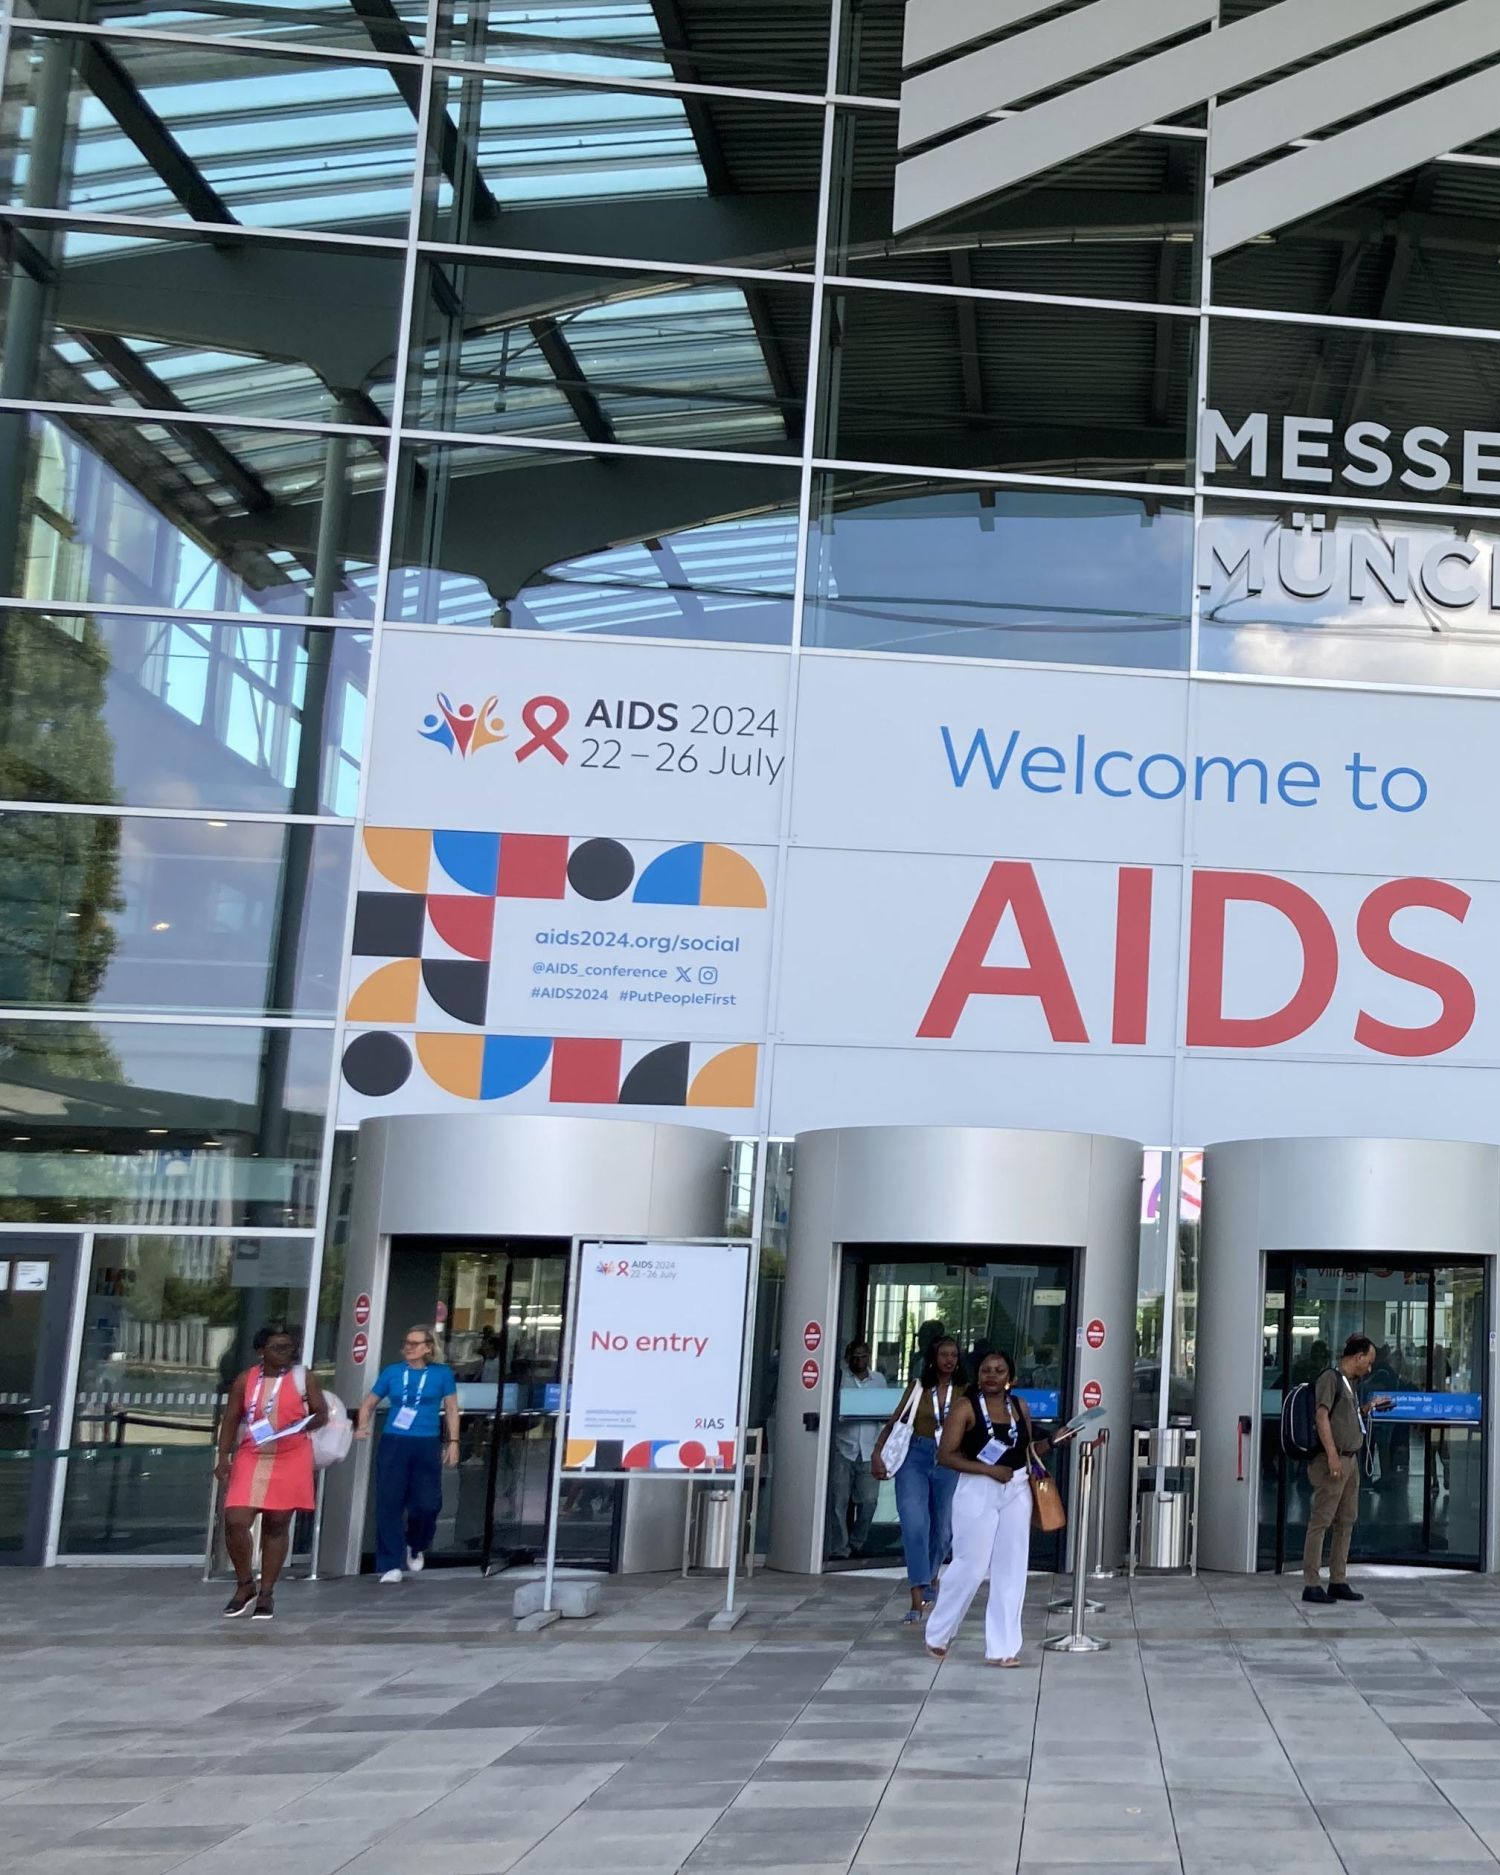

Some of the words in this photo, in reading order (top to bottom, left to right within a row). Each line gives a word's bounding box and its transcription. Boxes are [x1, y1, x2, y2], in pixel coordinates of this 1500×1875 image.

[584, 698, 679, 733] AIDS
[690, 704, 779, 738] 2024
[708, 746, 785, 786] July
[940, 725, 1321, 807] Welcome
[1345, 752, 1428, 813] to
[535, 928, 740, 953] aids2024.org/social
[532, 961, 668, 979] @AIDS_conference
[915, 860, 1476, 1058] AIDS
[531, 986, 609, 1001] #AIDS2024
[619, 990, 737, 1006] #PutPeopleFirst
[631, 1260, 653, 1269] AIDS
[591, 1330, 629, 1351] No
[636, 1333, 709, 1358] entry
[703, 1418, 725, 1429] IAS
